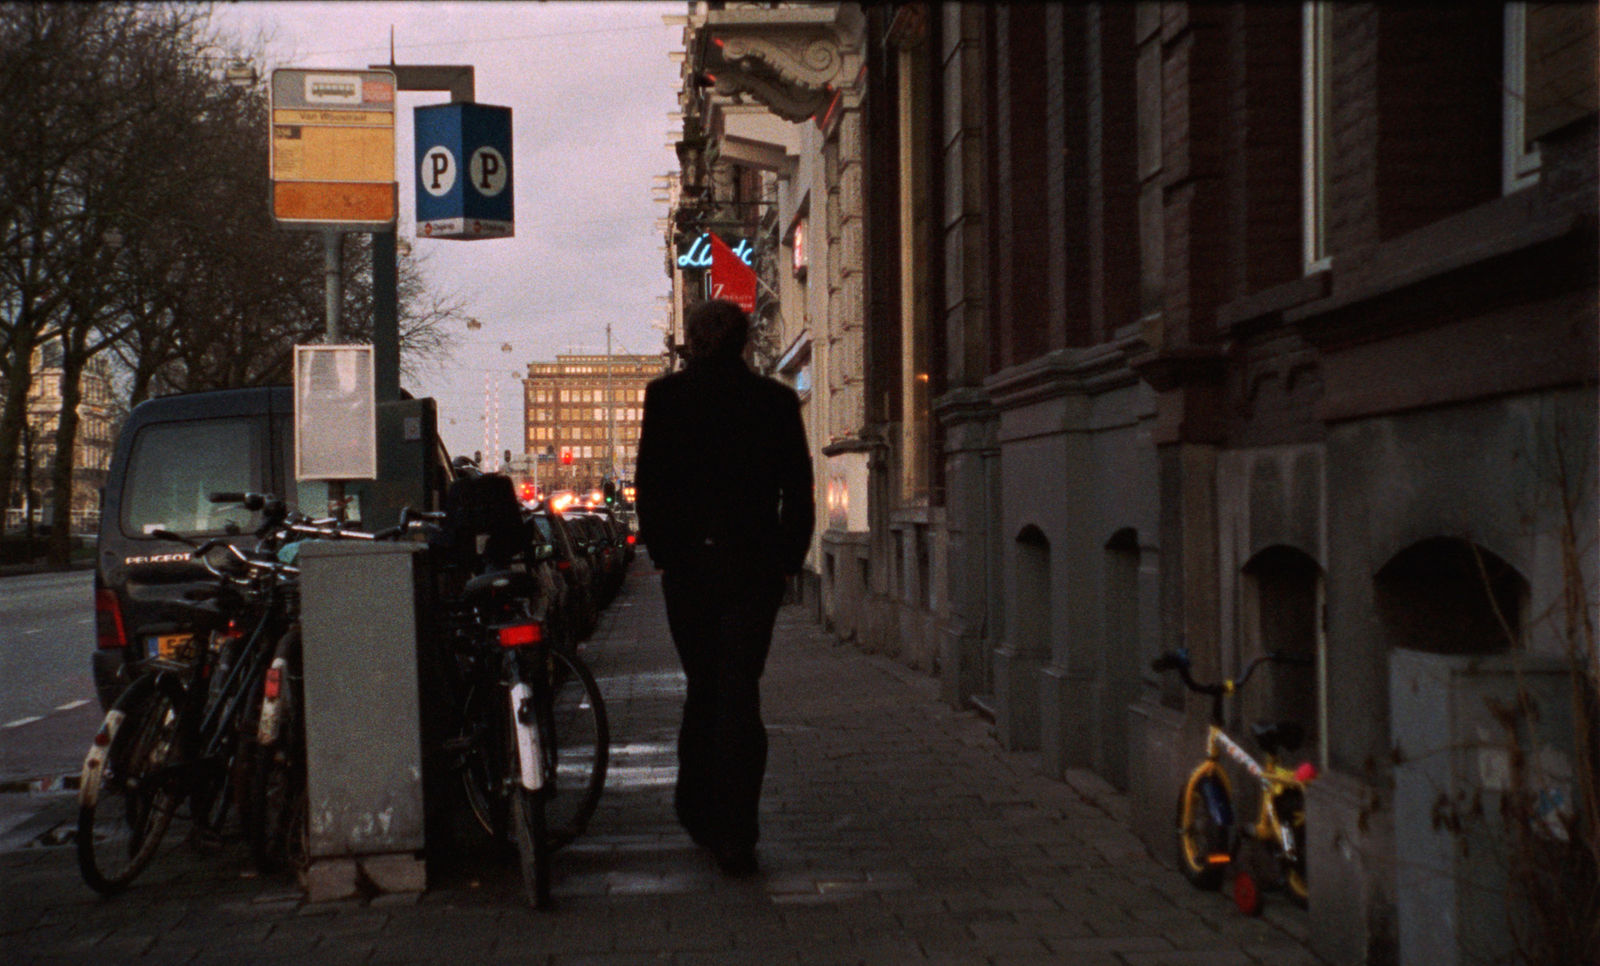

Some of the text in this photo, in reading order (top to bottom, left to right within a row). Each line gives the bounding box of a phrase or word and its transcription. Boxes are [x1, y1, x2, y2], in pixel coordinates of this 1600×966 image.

[431, 153, 448, 189] P
[480, 152, 499, 189] P
[125, 552, 191, 564] PEUGEOT
